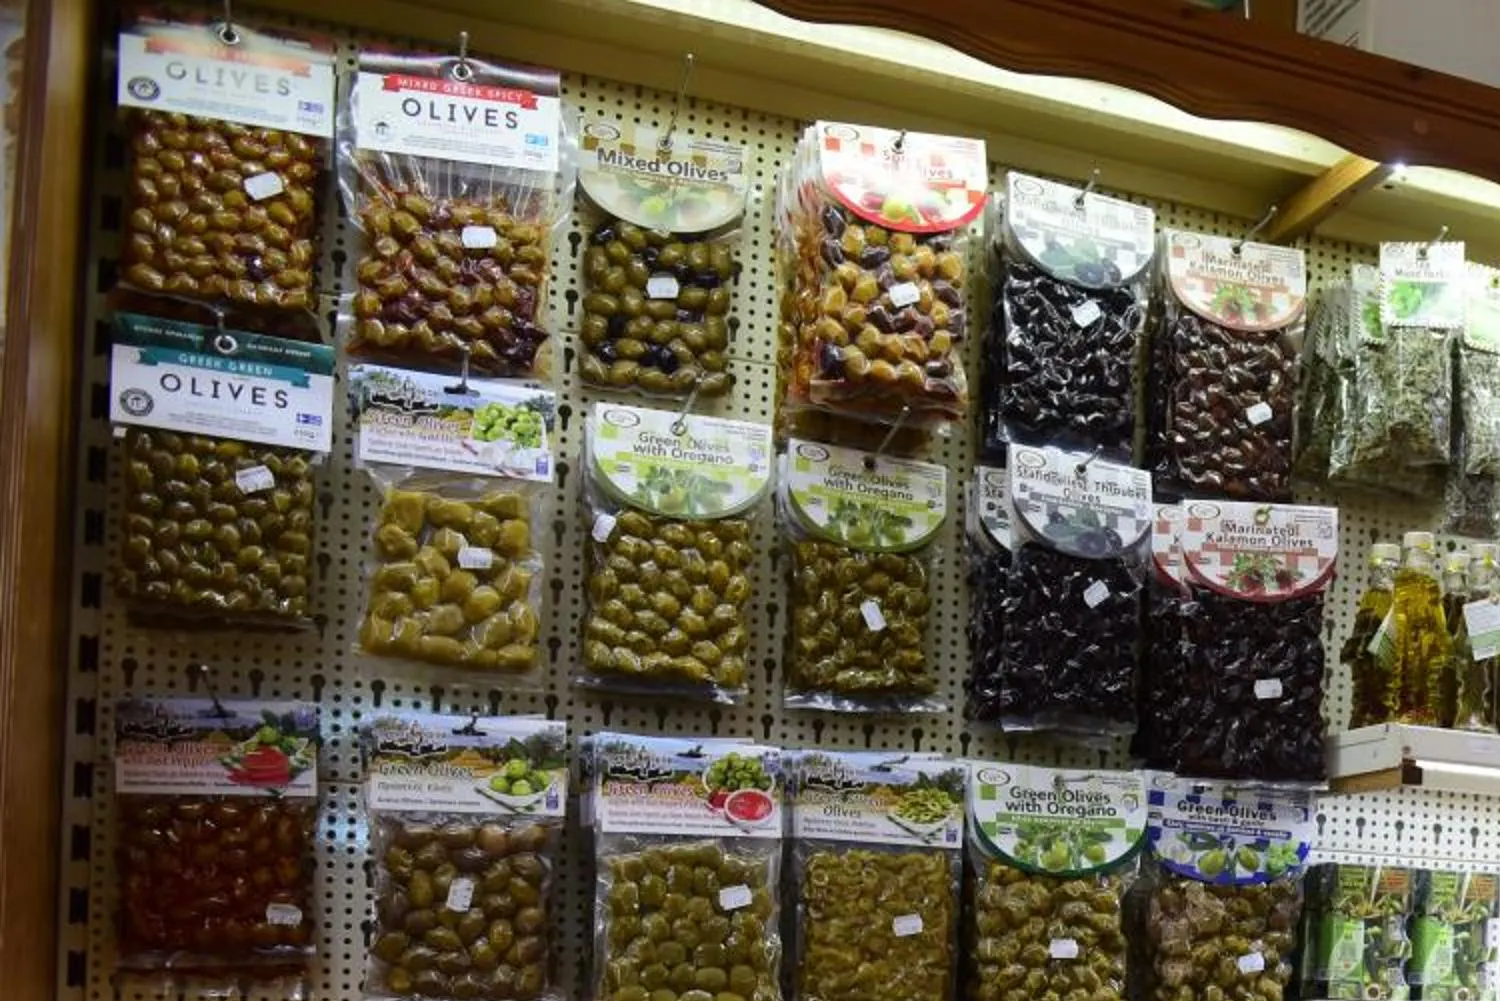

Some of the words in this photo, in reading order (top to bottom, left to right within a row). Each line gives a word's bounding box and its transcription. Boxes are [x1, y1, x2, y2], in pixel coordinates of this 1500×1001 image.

[166, 60, 291, 96] OLIVES
[401, 97, 519, 129] OLIVES
[596, 147, 661, 172] Mixed
[667, 160, 729, 182] Olives
[178, 352, 224, 369] GREEK
[227, 358, 273, 376] GREEN
[159, 372, 289, 409] OLIVES
[638, 431, 682, 449] Green
[671, 447, 735, 465] Oregano
[857, 483, 914, 501] Oregano
[1271, 535, 1314, 548] Olives
[1008, 785, 1057, 801] Green
[1063, 789, 1112, 804] Olives
[1047, 801, 1117, 819] Oregano
[1176, 799, 1225, 816] Green
[1229, 806, 1277, 821] Olives
